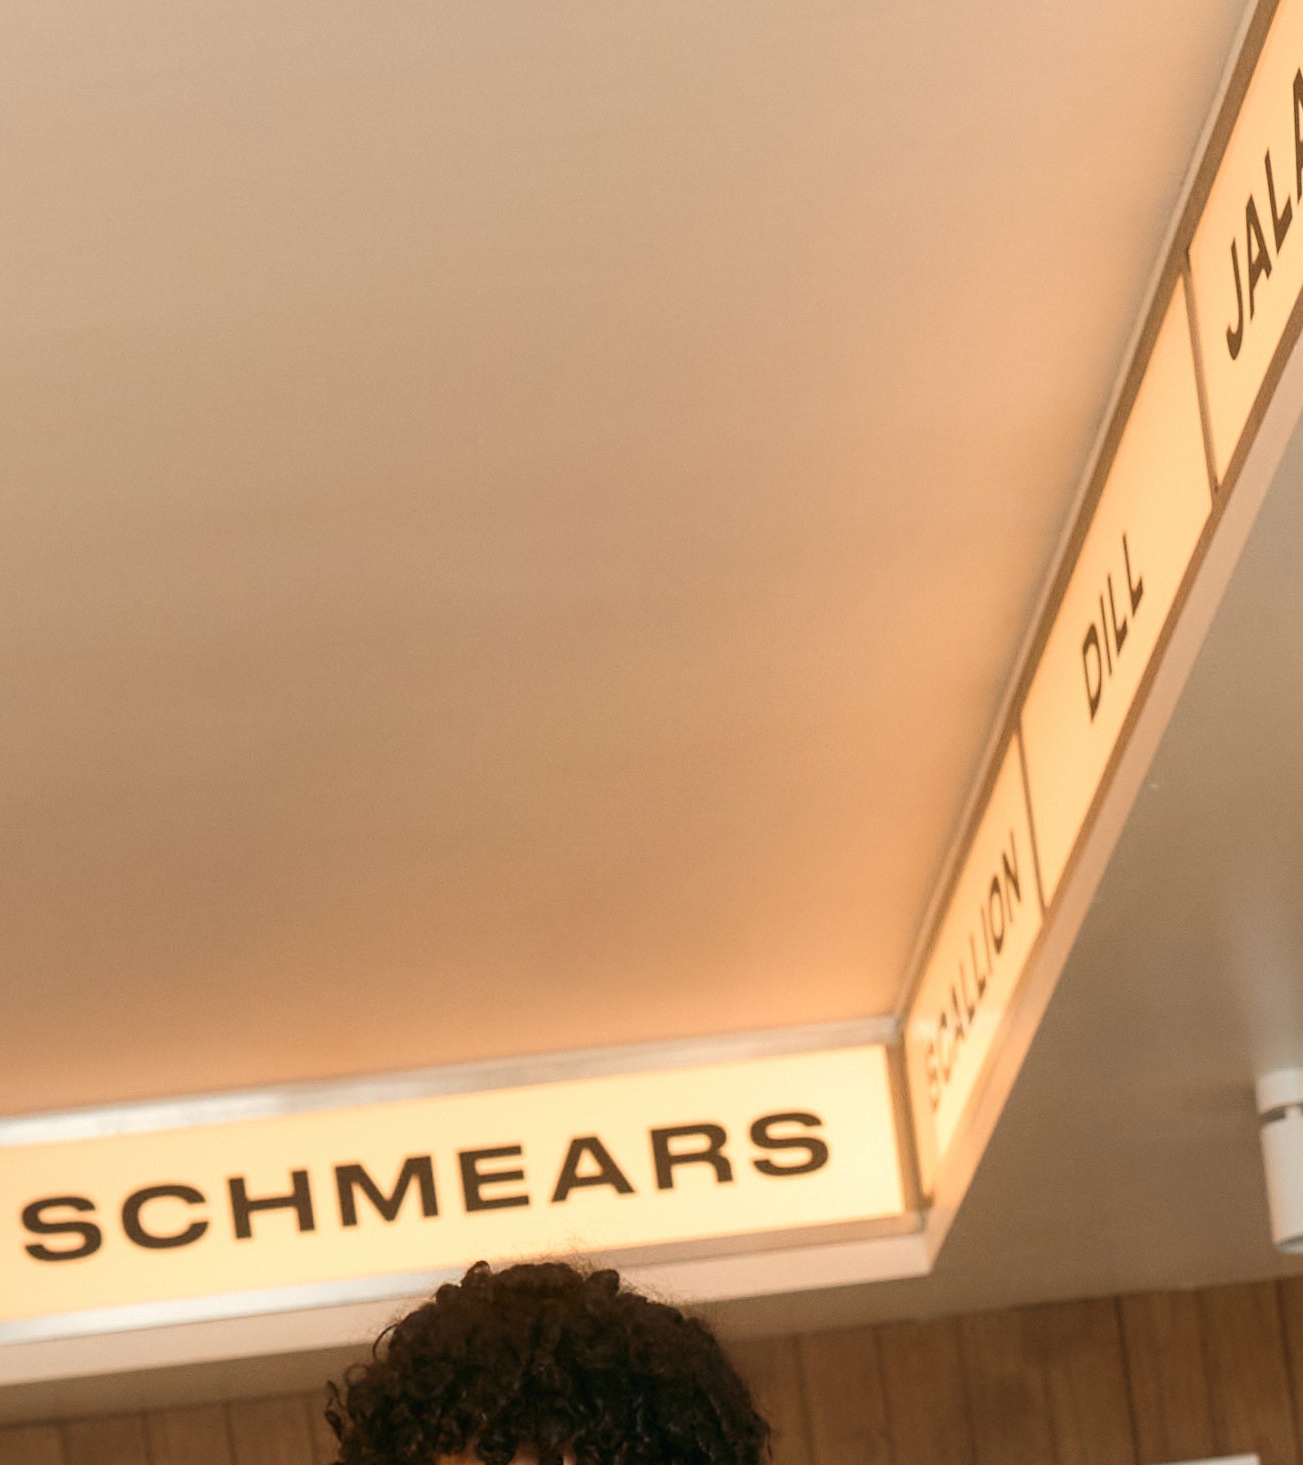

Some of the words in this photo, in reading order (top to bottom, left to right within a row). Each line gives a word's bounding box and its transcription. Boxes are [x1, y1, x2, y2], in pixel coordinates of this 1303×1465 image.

[1082, 530, 1145, 724] DILL
[924, 826, 1022, 1114] SCALLION
[20, 1110, 830, 1263] SCHMEARS
